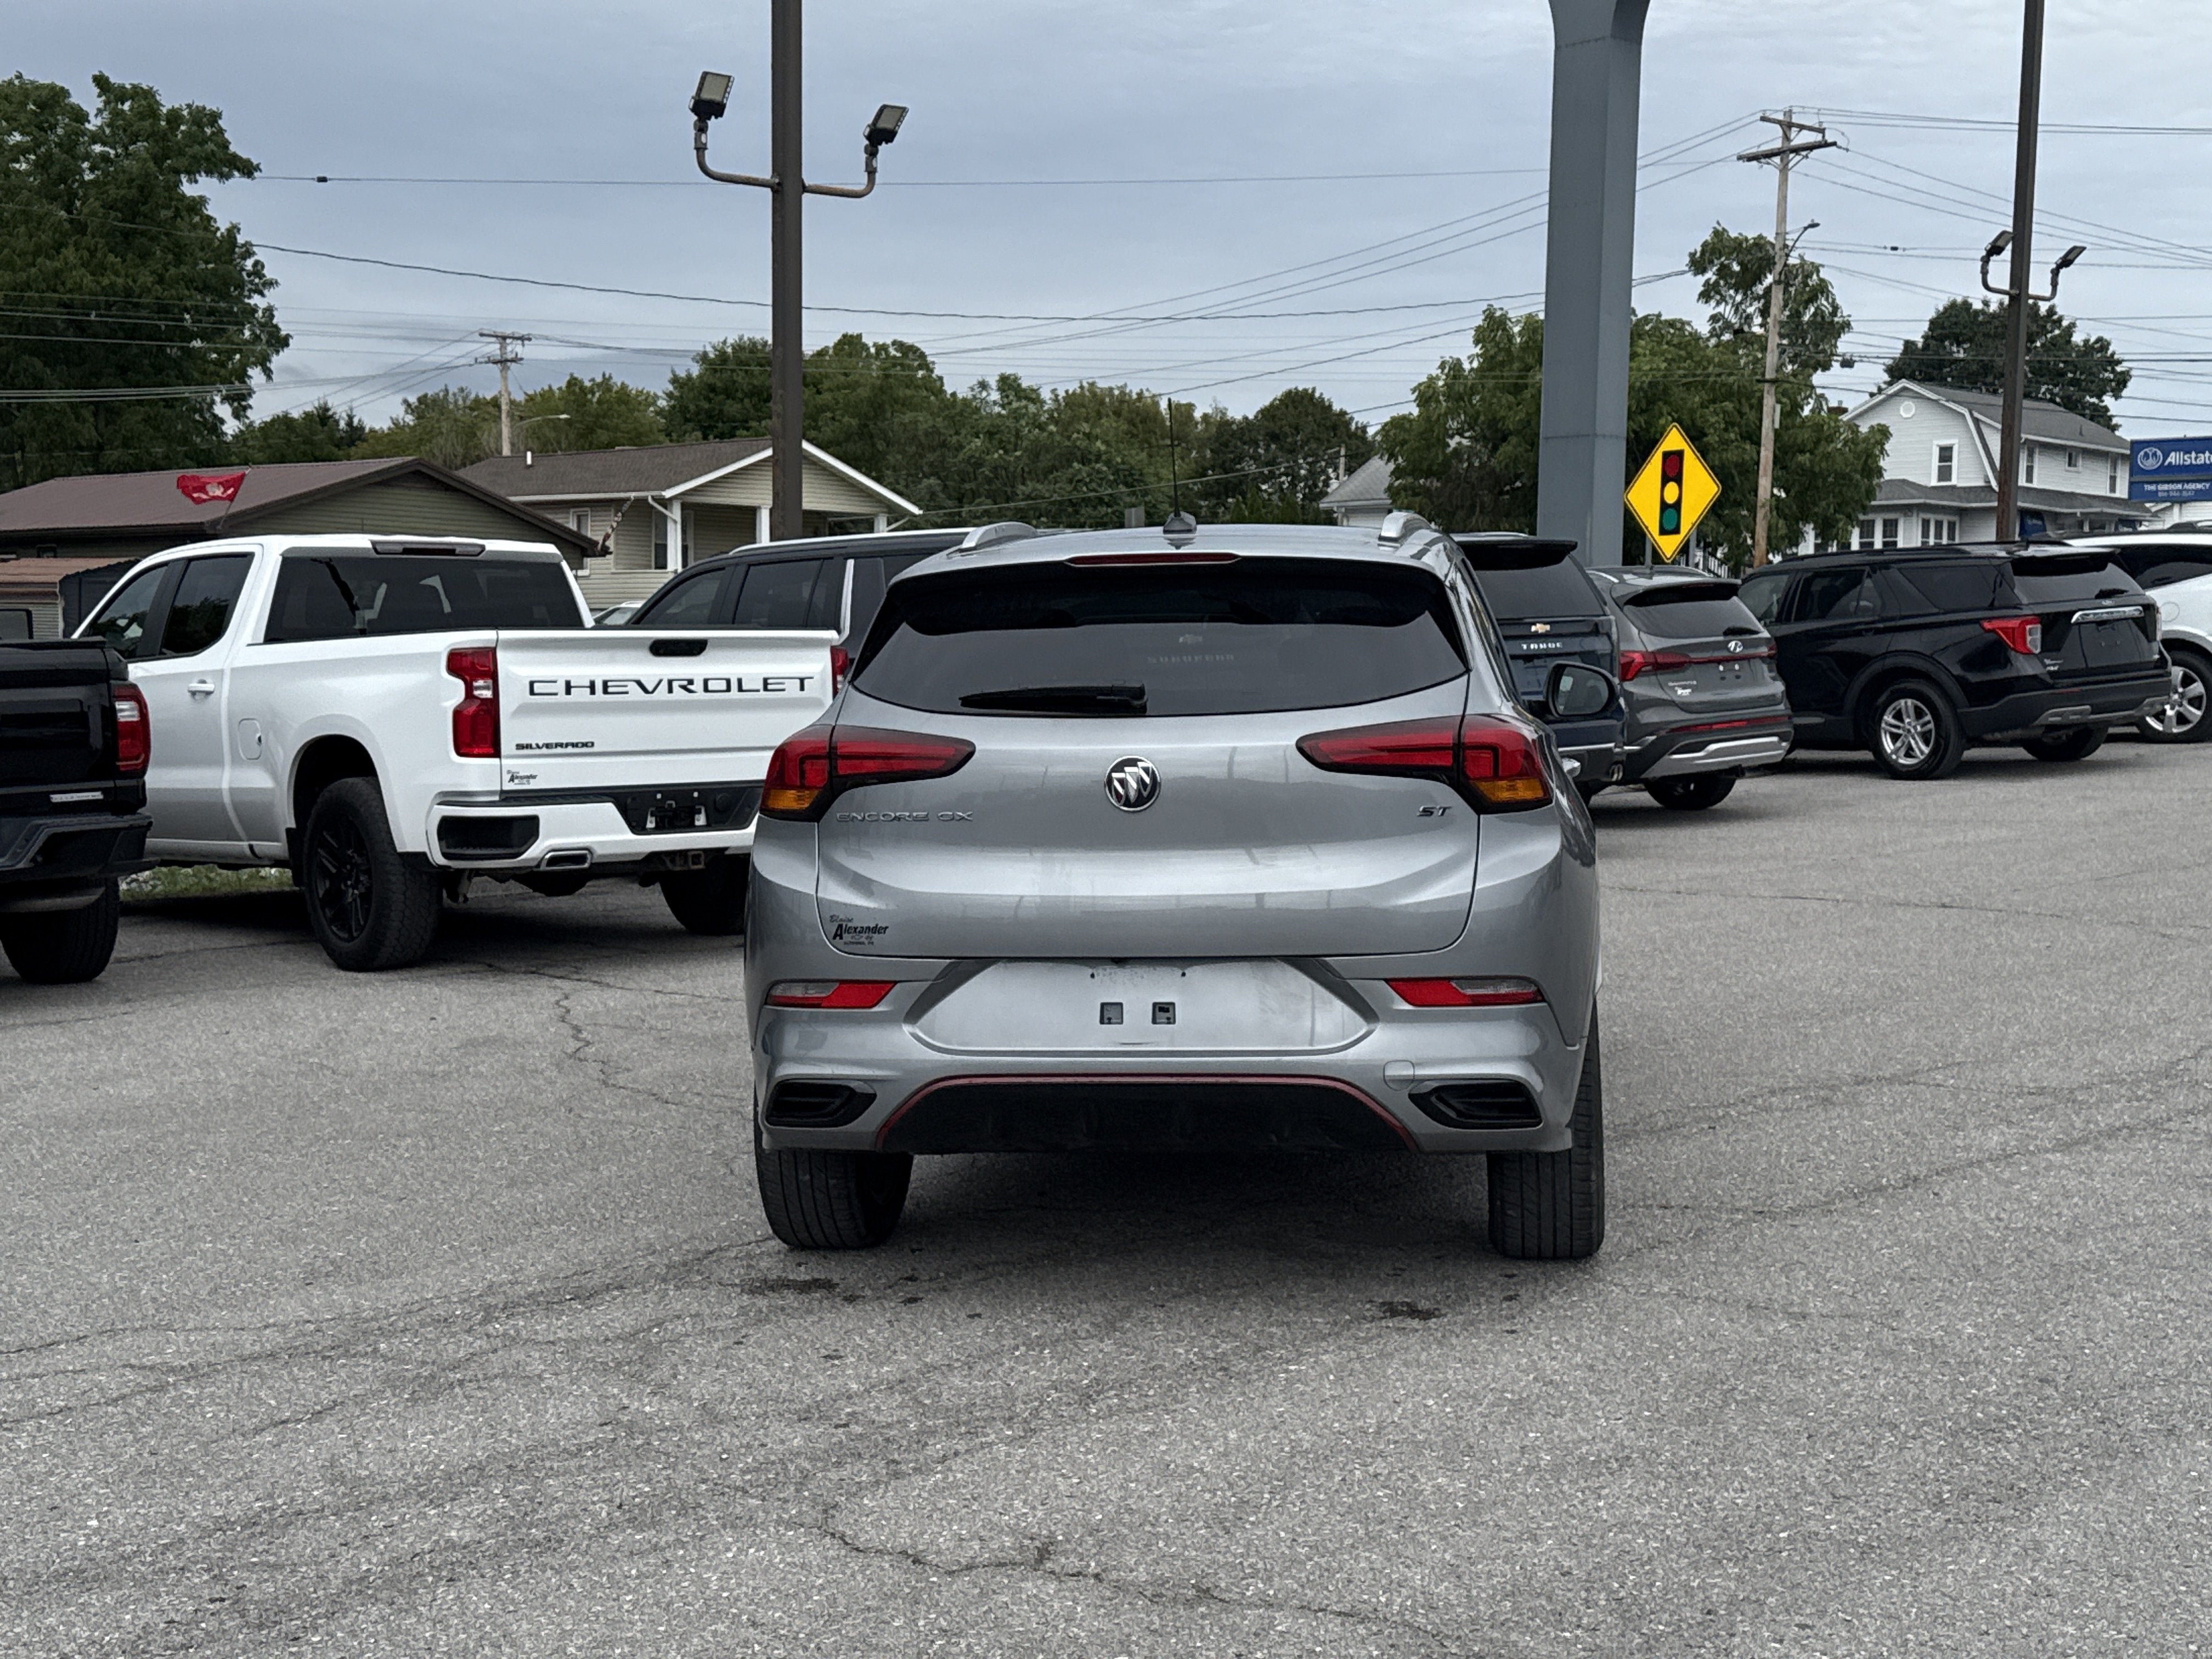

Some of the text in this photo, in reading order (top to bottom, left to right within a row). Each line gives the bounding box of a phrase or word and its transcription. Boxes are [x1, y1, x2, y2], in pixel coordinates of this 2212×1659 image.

[2164, 450, 2212, 466] Allstat
[528, 676, 814, 696] CHEVROLET
[515, 741, 595, 750] SILVERADO
[836, 811, 973, 822] ENCORE GX
[1417, 805, 1452, 817] ST
[833, 923, 889, 940] Alexander
